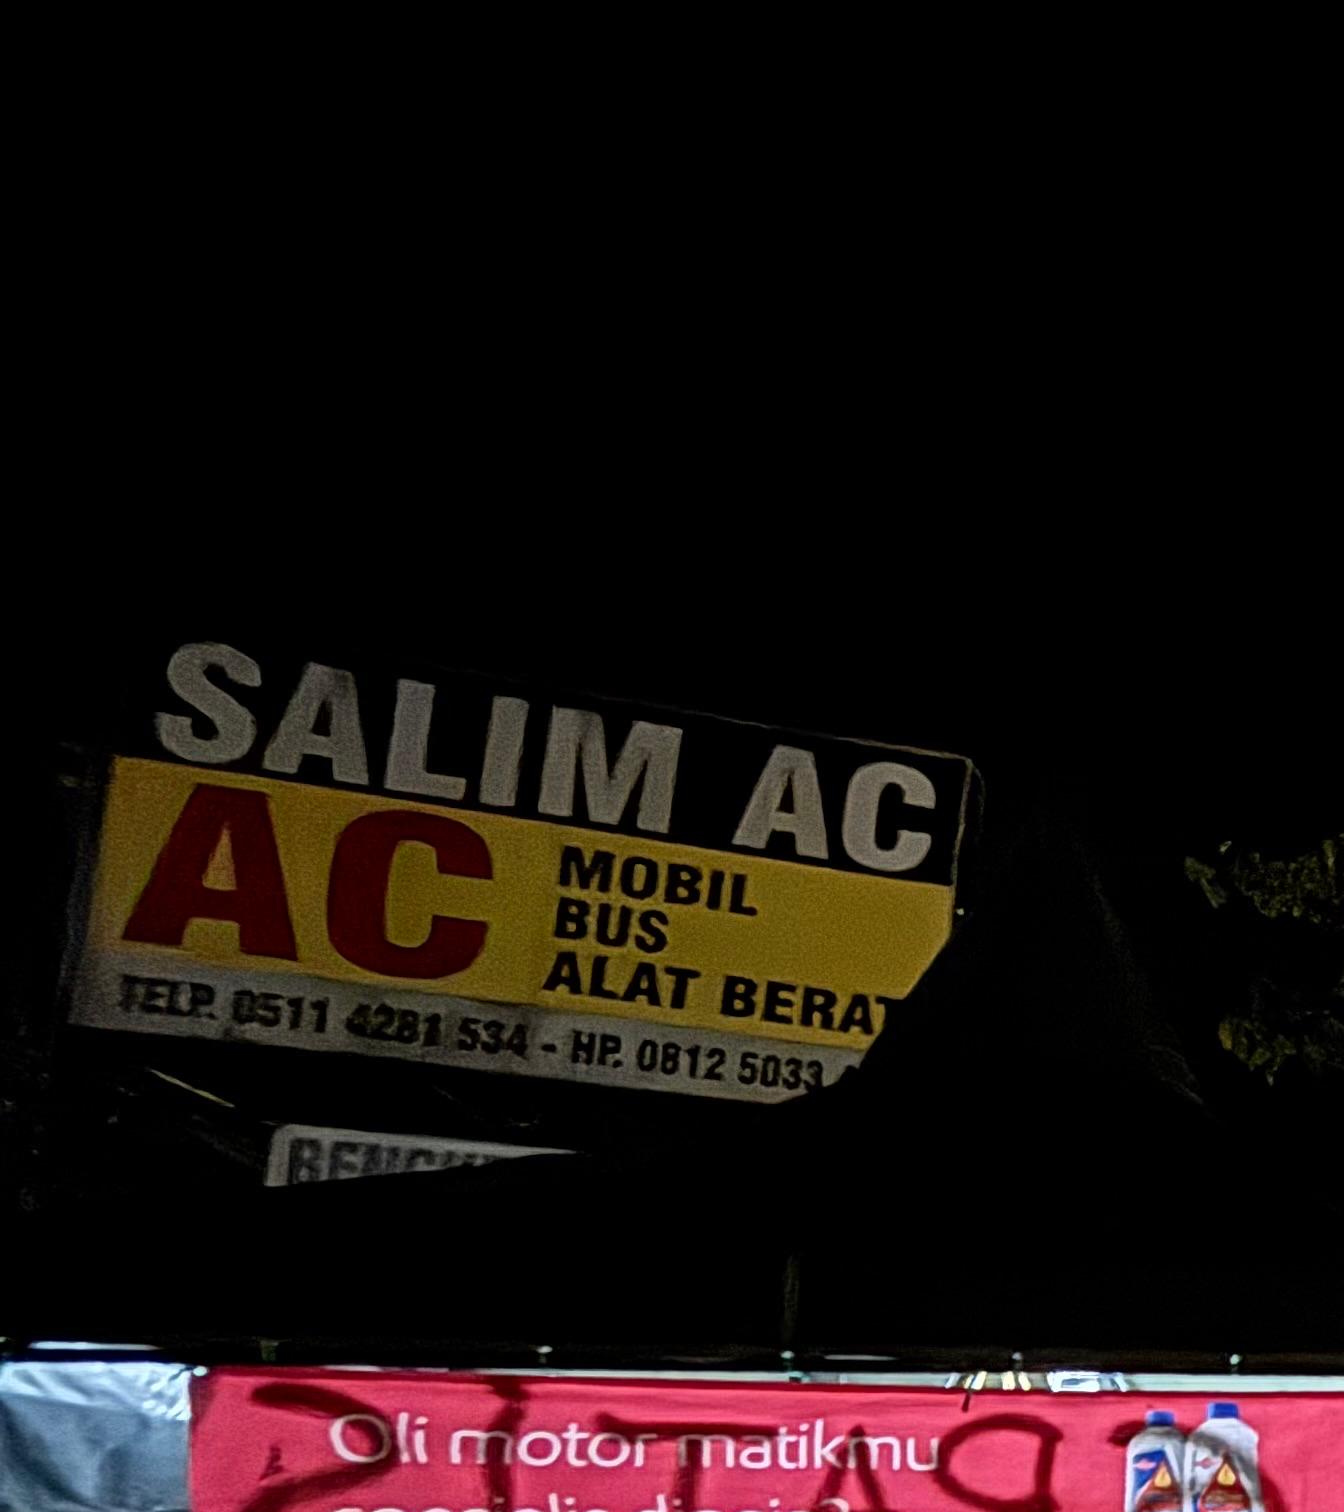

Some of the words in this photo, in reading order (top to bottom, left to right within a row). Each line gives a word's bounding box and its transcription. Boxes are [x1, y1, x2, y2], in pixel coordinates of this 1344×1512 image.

[156, 641, 684, 834] SALIM
[732, 744, 938, 872] AC
[120, 781, 496, 981] AC
[559, 844, 758, 917] MOBIL
[554, 896, 670, 954] BUS
[542, 951, 702, 1010] ALAT
[123, 974, 216, 1020] TELP.
[231, 990, 330, 1034] 0511
[458, 1016, 529, 1060] 534
[571, 1029, 622, 1069] HP.
[636, 1039, 727, 1081] 0812
[328, 1412, 429, 1465] Oli
[449, 1421, 654, 1468] motor
[679, 1417, 940, 1473] matikmu
